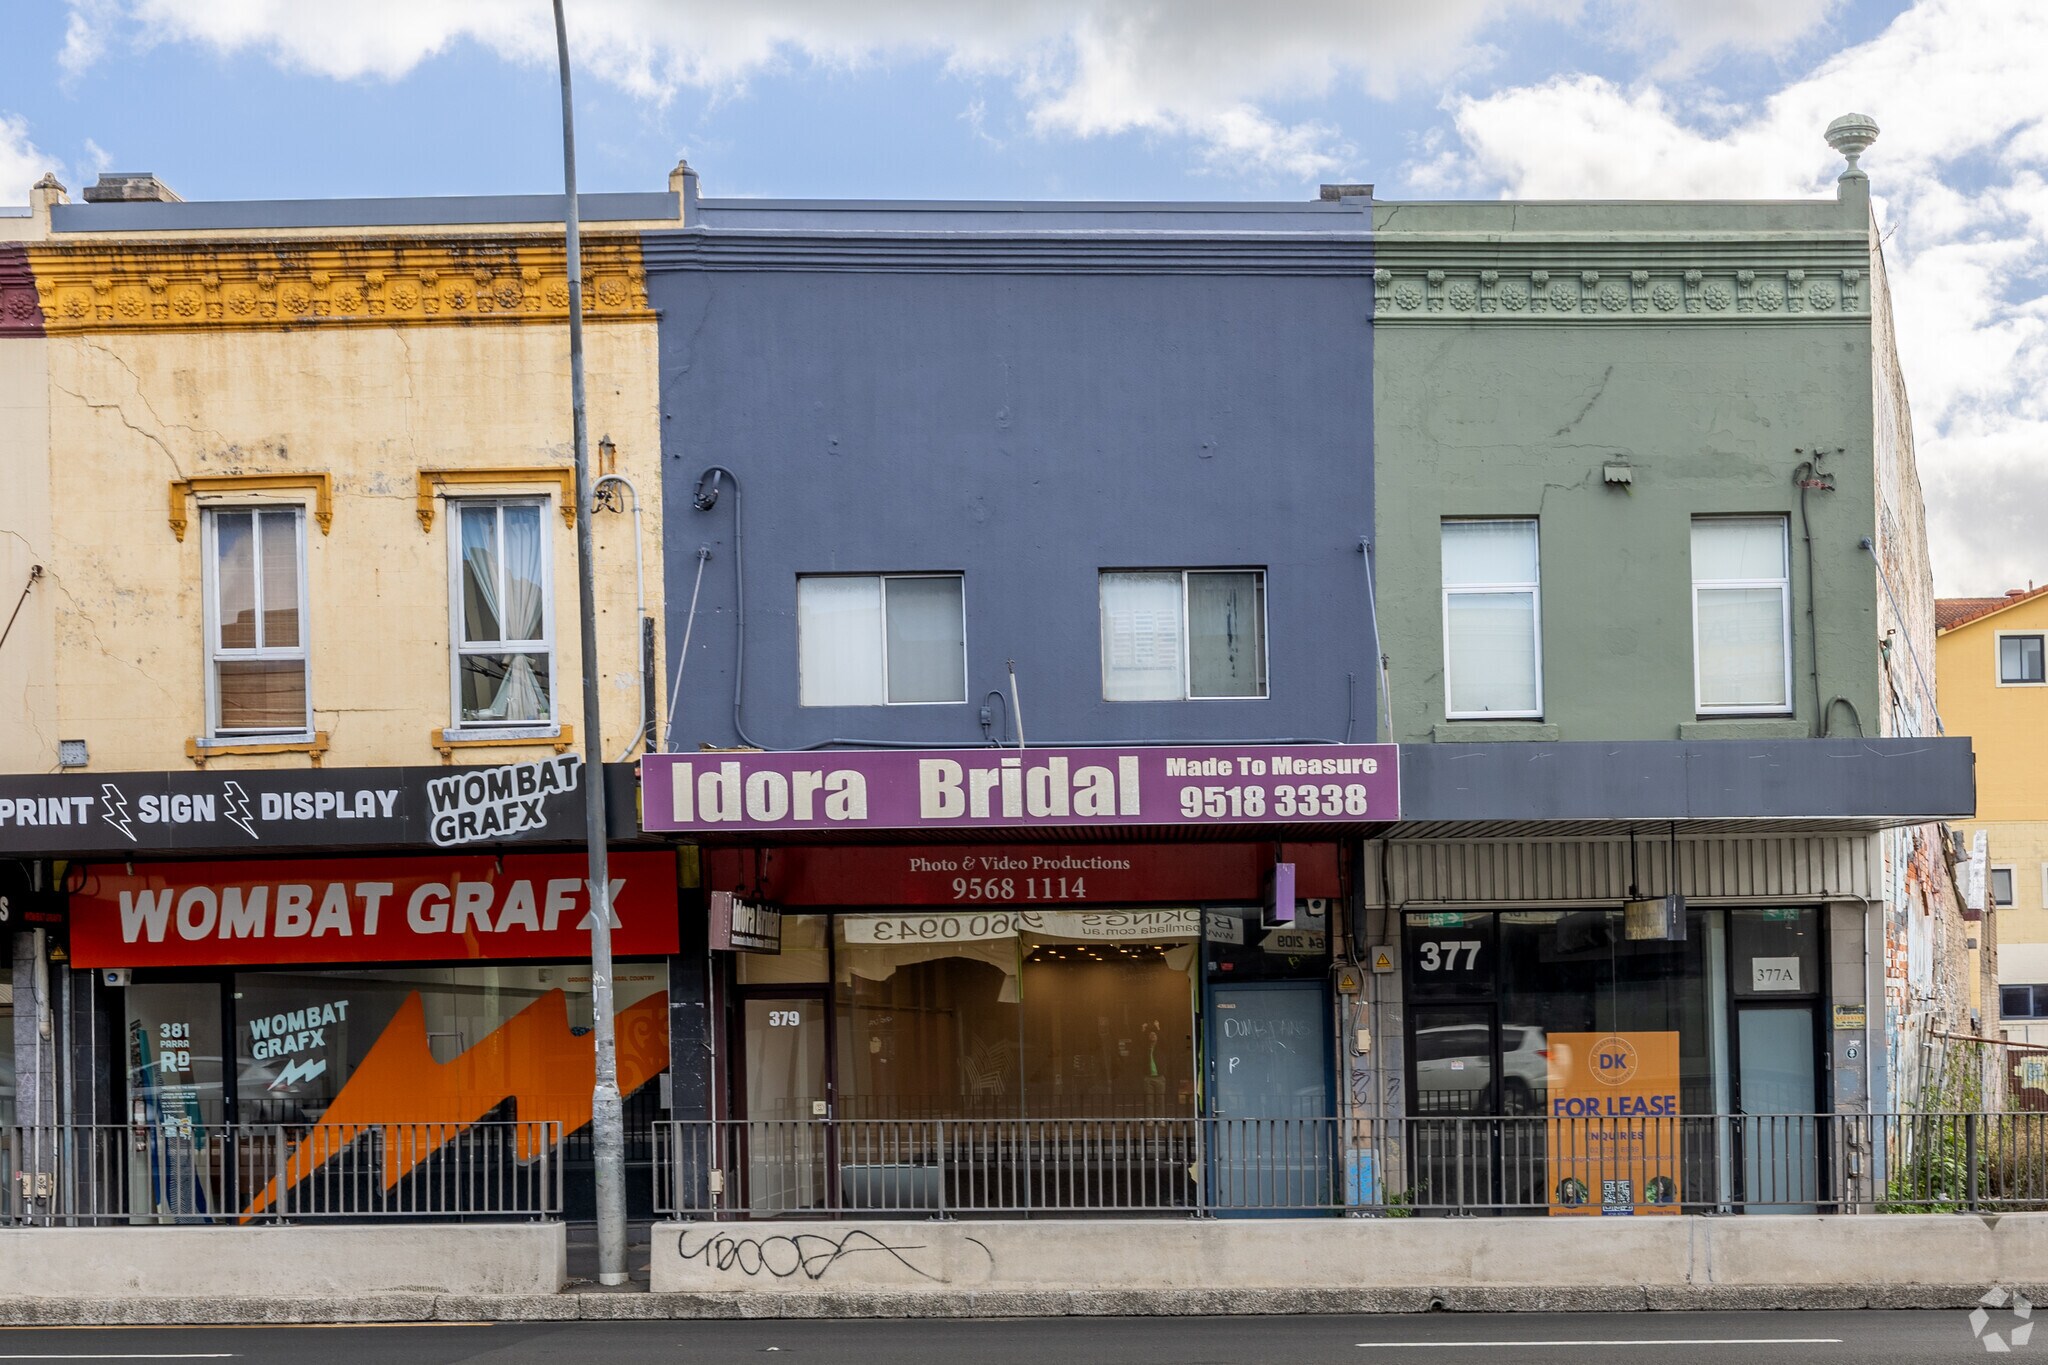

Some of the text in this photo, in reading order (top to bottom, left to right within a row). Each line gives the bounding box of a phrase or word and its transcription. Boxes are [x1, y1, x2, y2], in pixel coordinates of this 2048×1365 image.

[1166, 755, 1378, 777] Made To Measure
[431, 756, 579, 813] WOMBAT
[672, 755, 1140, 822] Idora Bridal
[0, 790, 398, 826] PRINT SIGN DISPLAY
[1180, 784, 1368, 819] 9518 3338
[435, 799, 543, 842] GRAFX
[909, 855, 1131, 872] Photo & Video Productions
[952, 877, 1087, 899] 9568 1114
[119, 878, 627, 943] WOMBAT GRAFX
[1419, 940, 1482, 971] 377
[1757, 969, 1794, 982] 377A
[250, 1000, 349, 1040] WOMBAT
[768, 1011, 800, 1027] 379
[160, 1023, 190, 1038] 381
[160, 1040, 190, 1048] PARRA
[252, 1029, 326, 1060] GRAFX
[160, 1051, 190, 1072] RD
[1600, 1053, 1627, 1070] DK
[1554, 1095, 1676, 1117] FOR LEASE
